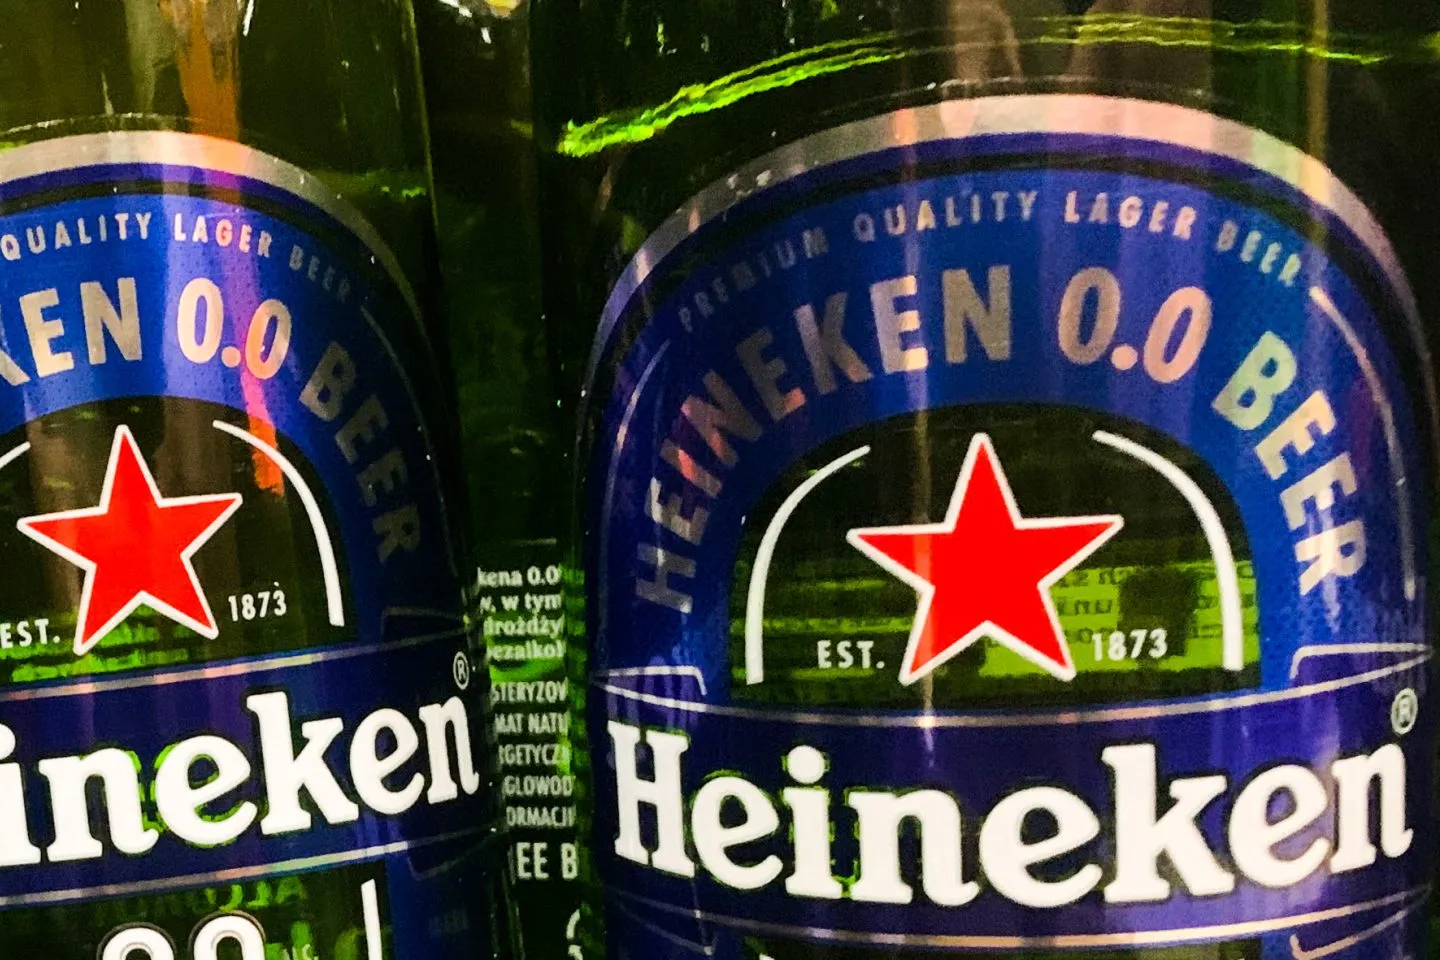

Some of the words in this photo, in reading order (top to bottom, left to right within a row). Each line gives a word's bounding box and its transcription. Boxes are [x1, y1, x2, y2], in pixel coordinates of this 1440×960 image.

[0, 211, 152, 262] QUALITY
[174, 212, 273, 258] LAGER
[288, 244, 353, 302] BEER
[678, 226, 829, 332] PREMIUM
[853, 189, 1038, 243] QUALITY
[1064, 190, 1197, 241] LAGER
[1216, 219, 1302, 287] BEER
[177, 277, 292, 380] 0.0
[298, 339, 422, 566] BEER
[634, 264, 1013, 615] HEINEKEN
[1058, 265, 1213, 385] 0.0
[1211, 330, 1367, 597] BEER
[227, 588, 288, 623] 1873
[816, 639, 886, 670] EST.
[1091, 628, 1169, 663] 1873
[608, 718, 1414, 909] Heineken
